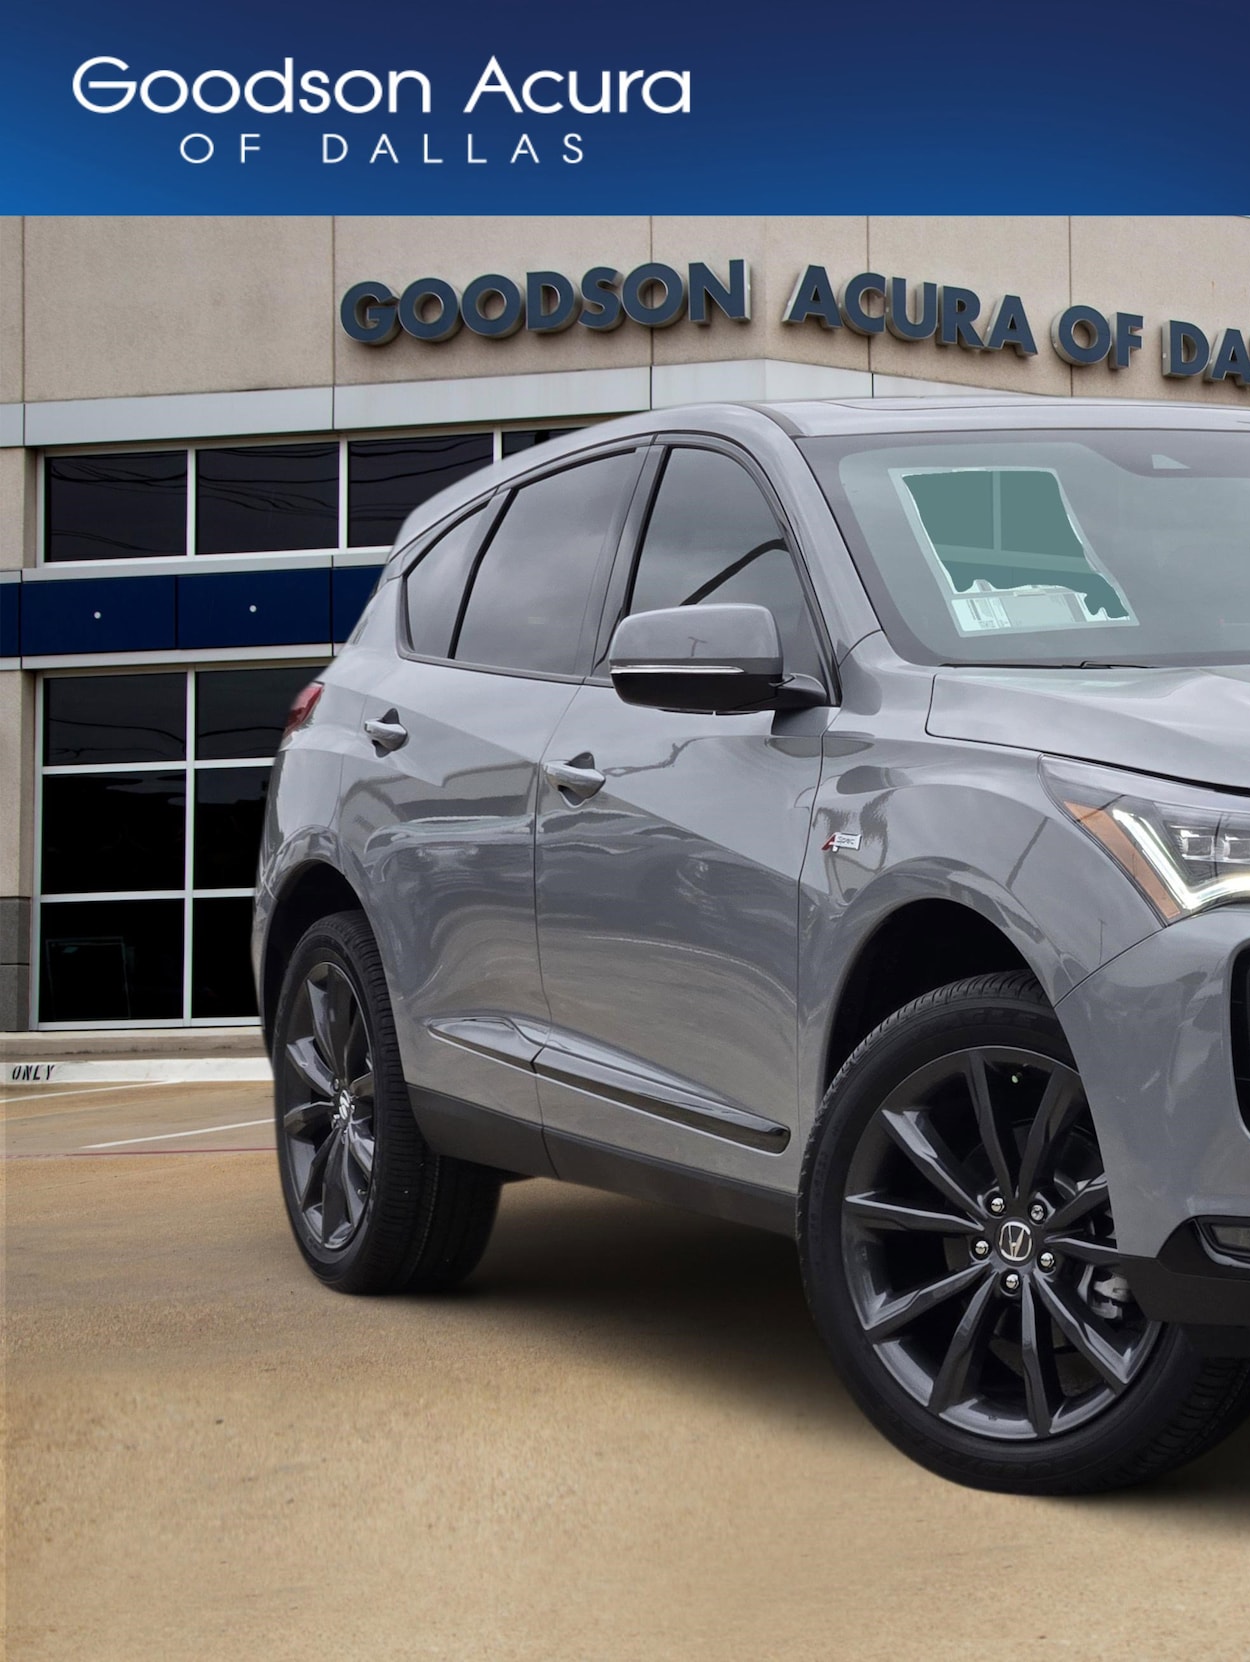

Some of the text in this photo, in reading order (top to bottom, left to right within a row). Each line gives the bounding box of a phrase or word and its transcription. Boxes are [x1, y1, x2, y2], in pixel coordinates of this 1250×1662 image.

[340, 259, 752, 343] GOODSON
[782, 264, 1038, 356] ACURA
[1051, 305, 1144, 370] OF
[12, 1064, 55, 1081] ONLY
